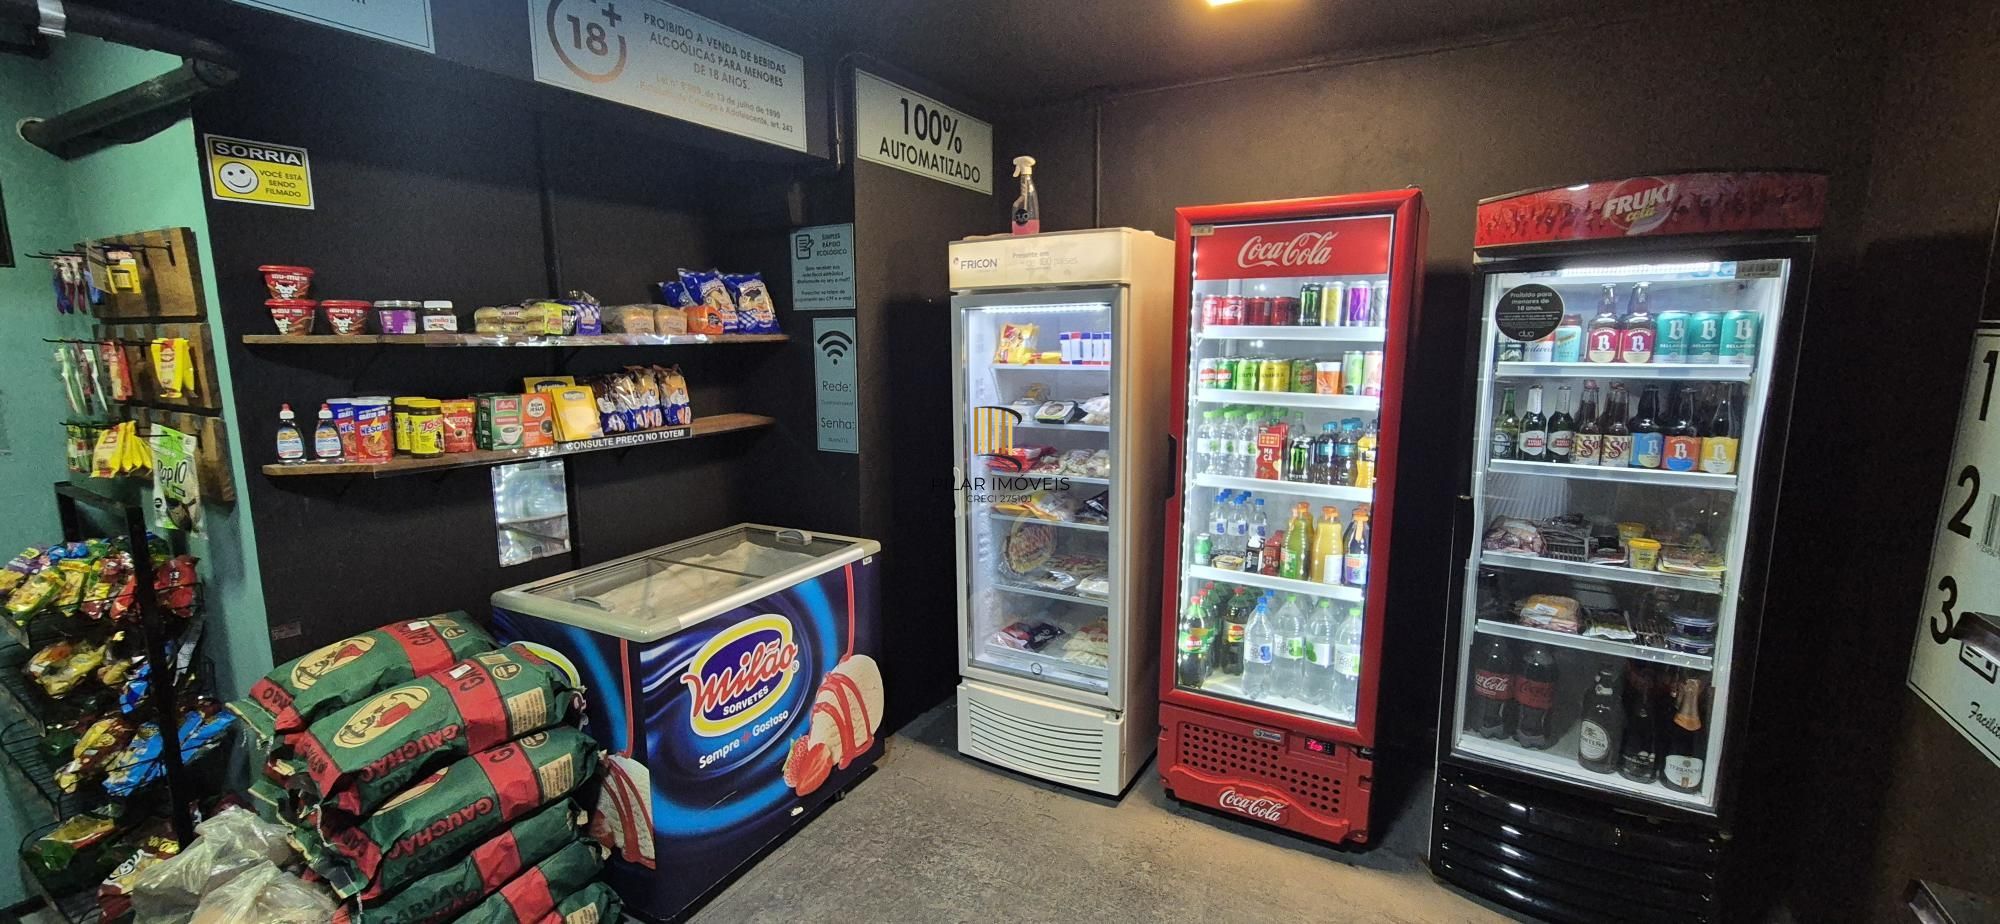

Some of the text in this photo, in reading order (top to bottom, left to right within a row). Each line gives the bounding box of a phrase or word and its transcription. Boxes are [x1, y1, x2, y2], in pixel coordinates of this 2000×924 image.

[643, 12, 786, 75] PROIBIDO A VENDA DE BEBIDAS
[650, 31, 784, 88] ALCOÓLICAS PARA MENORES
[693, 62, 706, 77] DE
[708, 68, 719, 81] 18
[727, 95, 735, 106] de
[756, 105, 765, 115] de
[901, 97, 963, 154] 100%
[215, 142, 301, 166] SORRIA
[880, 137, 981, 183] AUTOMATIZADO
[265, 187, 301, 198] FILMADO
[268, 179, 296, 189] SENDO
[1601, 183, 1679, 219] FRUKI
[1624, 206, 1659, 223] cola
[1237, 231, 1339, 268] Coca-Cola
[960, 258, 998, 270] FRICON
[1669, 320, 1684, 340] B
[1701, 320, 1716, 340] B
[1735, 319, 1752, 340] B
[822, 380, 852, 393] Rede:
[1978, 349, 2000, 422] 1
[820, 417, 856, 431] Senha:
[565, 438, 614, 450] CONSULTE
[615, 434, 643, 446] PREÇO
[645, 433, 658, 441] NO
[660, 429, 684, 439] TOTEM
[1946, 464, 1981, 539] 2
[1930, 575, 1958, 645] 3
[722, 685, 769, 716] SORVETES
[699, 738, 740, 769] Sempre
[752, 710, 789, 737] Gostoso
[1219, 787, 1290, 822] Coca-Cola
